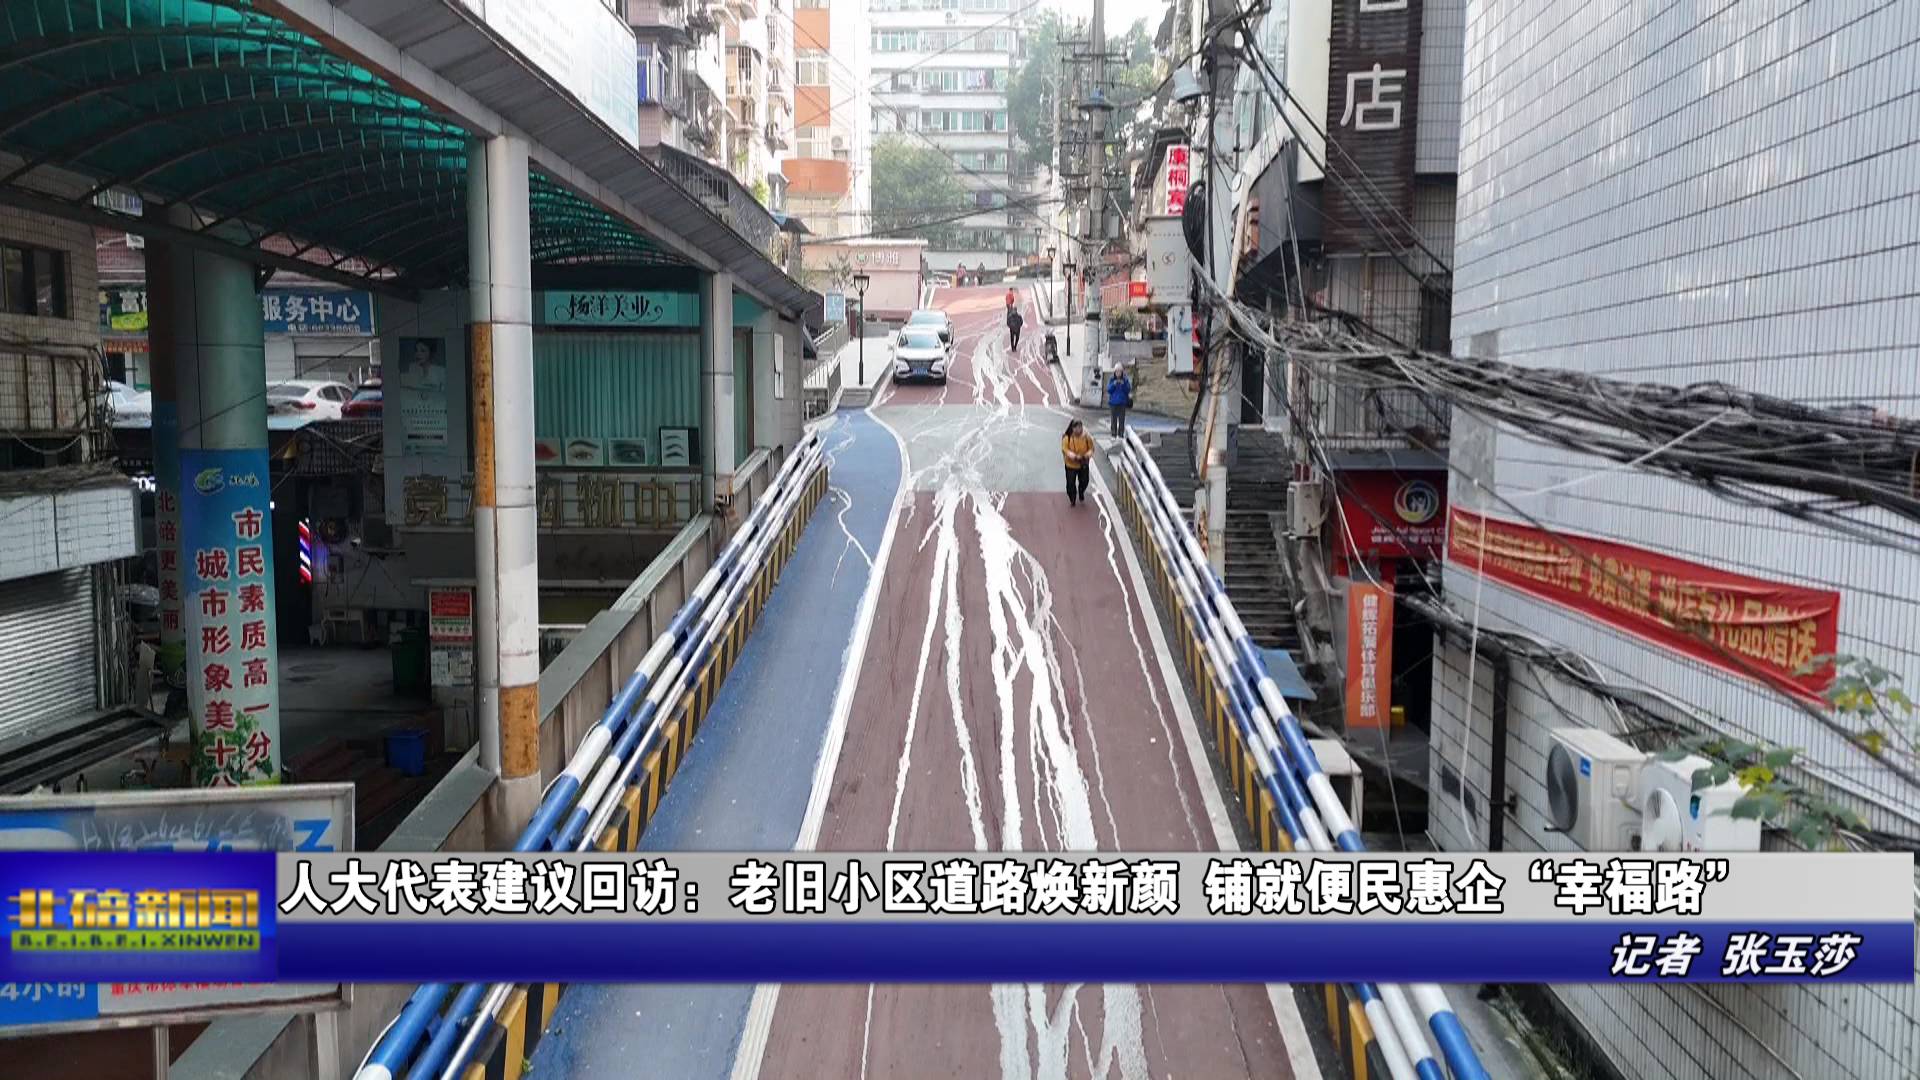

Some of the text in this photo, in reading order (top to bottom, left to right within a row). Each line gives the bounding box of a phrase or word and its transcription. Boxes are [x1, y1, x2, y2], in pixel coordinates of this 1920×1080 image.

[233, 506, 272, 770] 市民素质高一分
